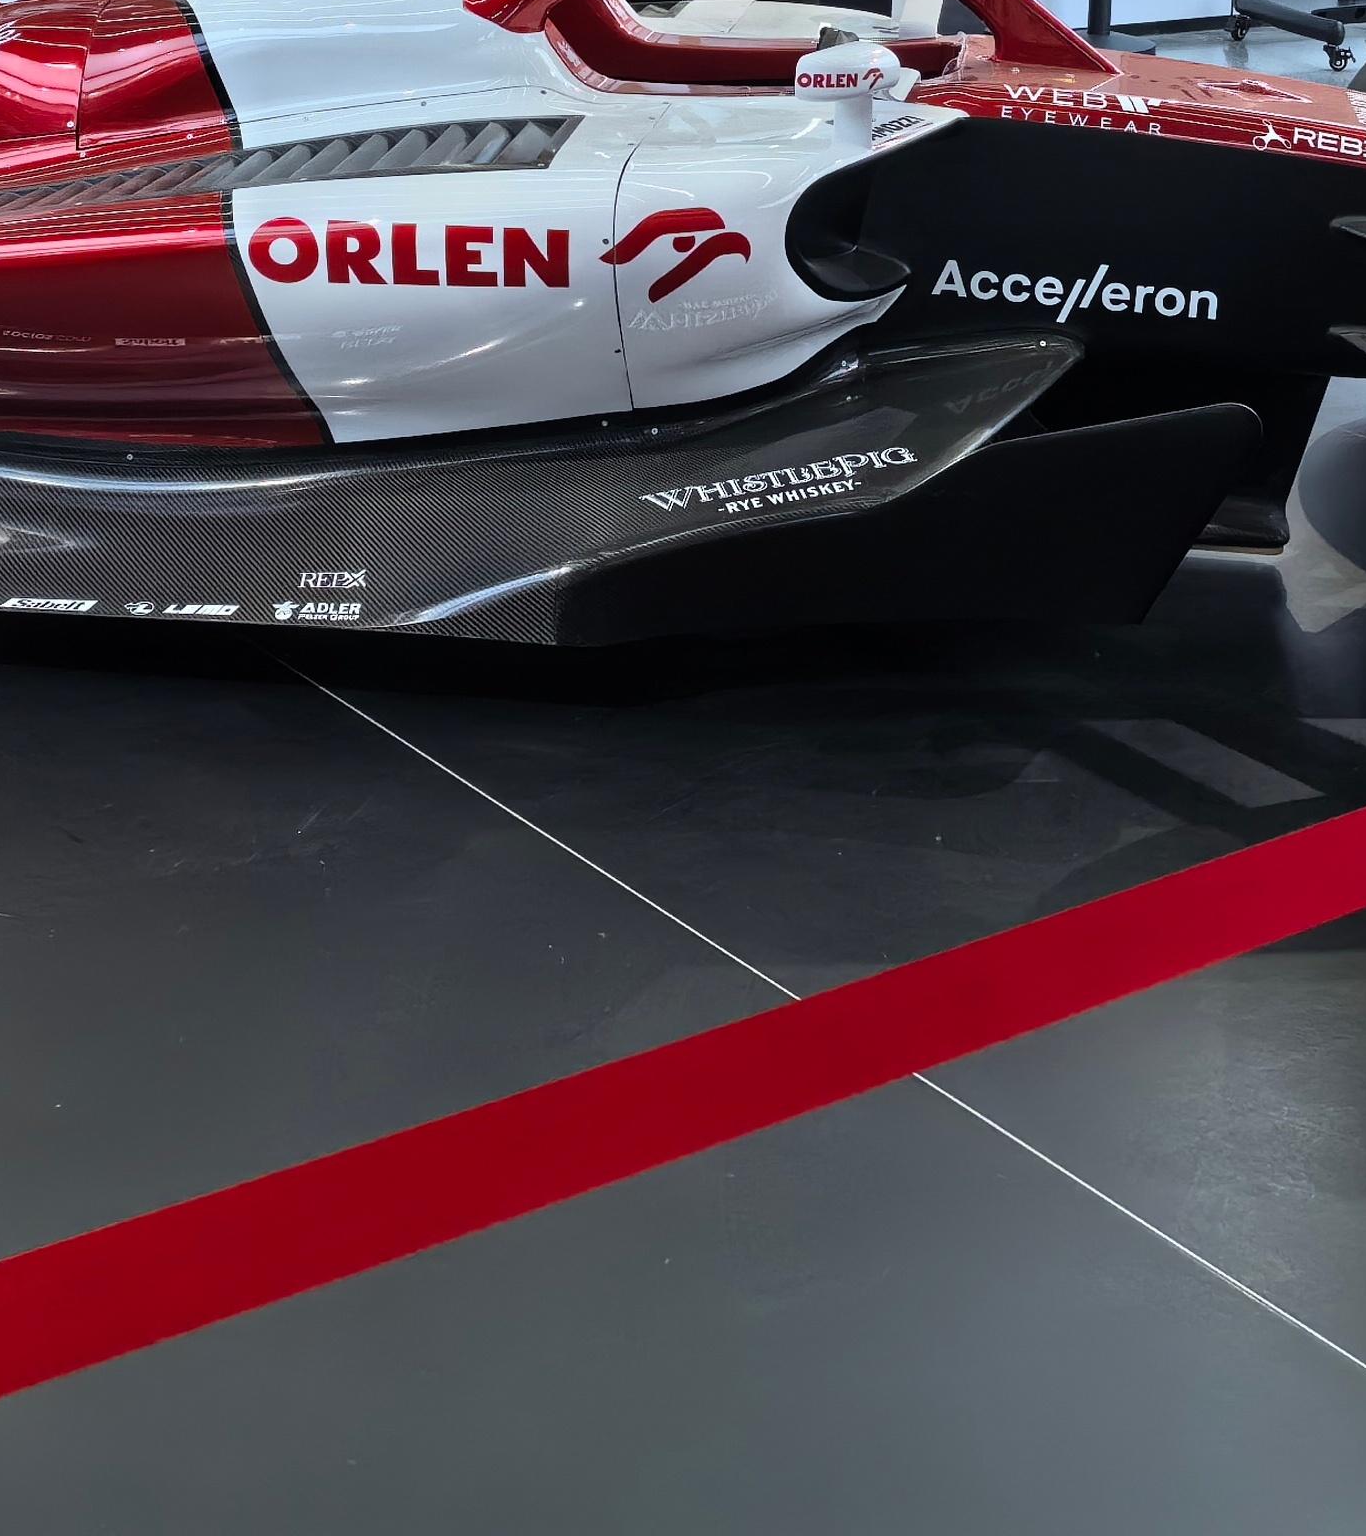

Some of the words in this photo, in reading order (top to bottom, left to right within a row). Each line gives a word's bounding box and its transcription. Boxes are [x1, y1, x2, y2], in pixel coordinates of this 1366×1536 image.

[796, 72, 859, 89] ORLEN
[1003, 83, 1109, 110] WEB
[1000, 105, 1162, 137] EYEWEAR
[248, 216, 571, 289] ORLEN
[639, 447, 919, 512] WHISTLEPIG
[297, 569, 367, 589] REPX
[299, 602, 363, 615] ADLER
